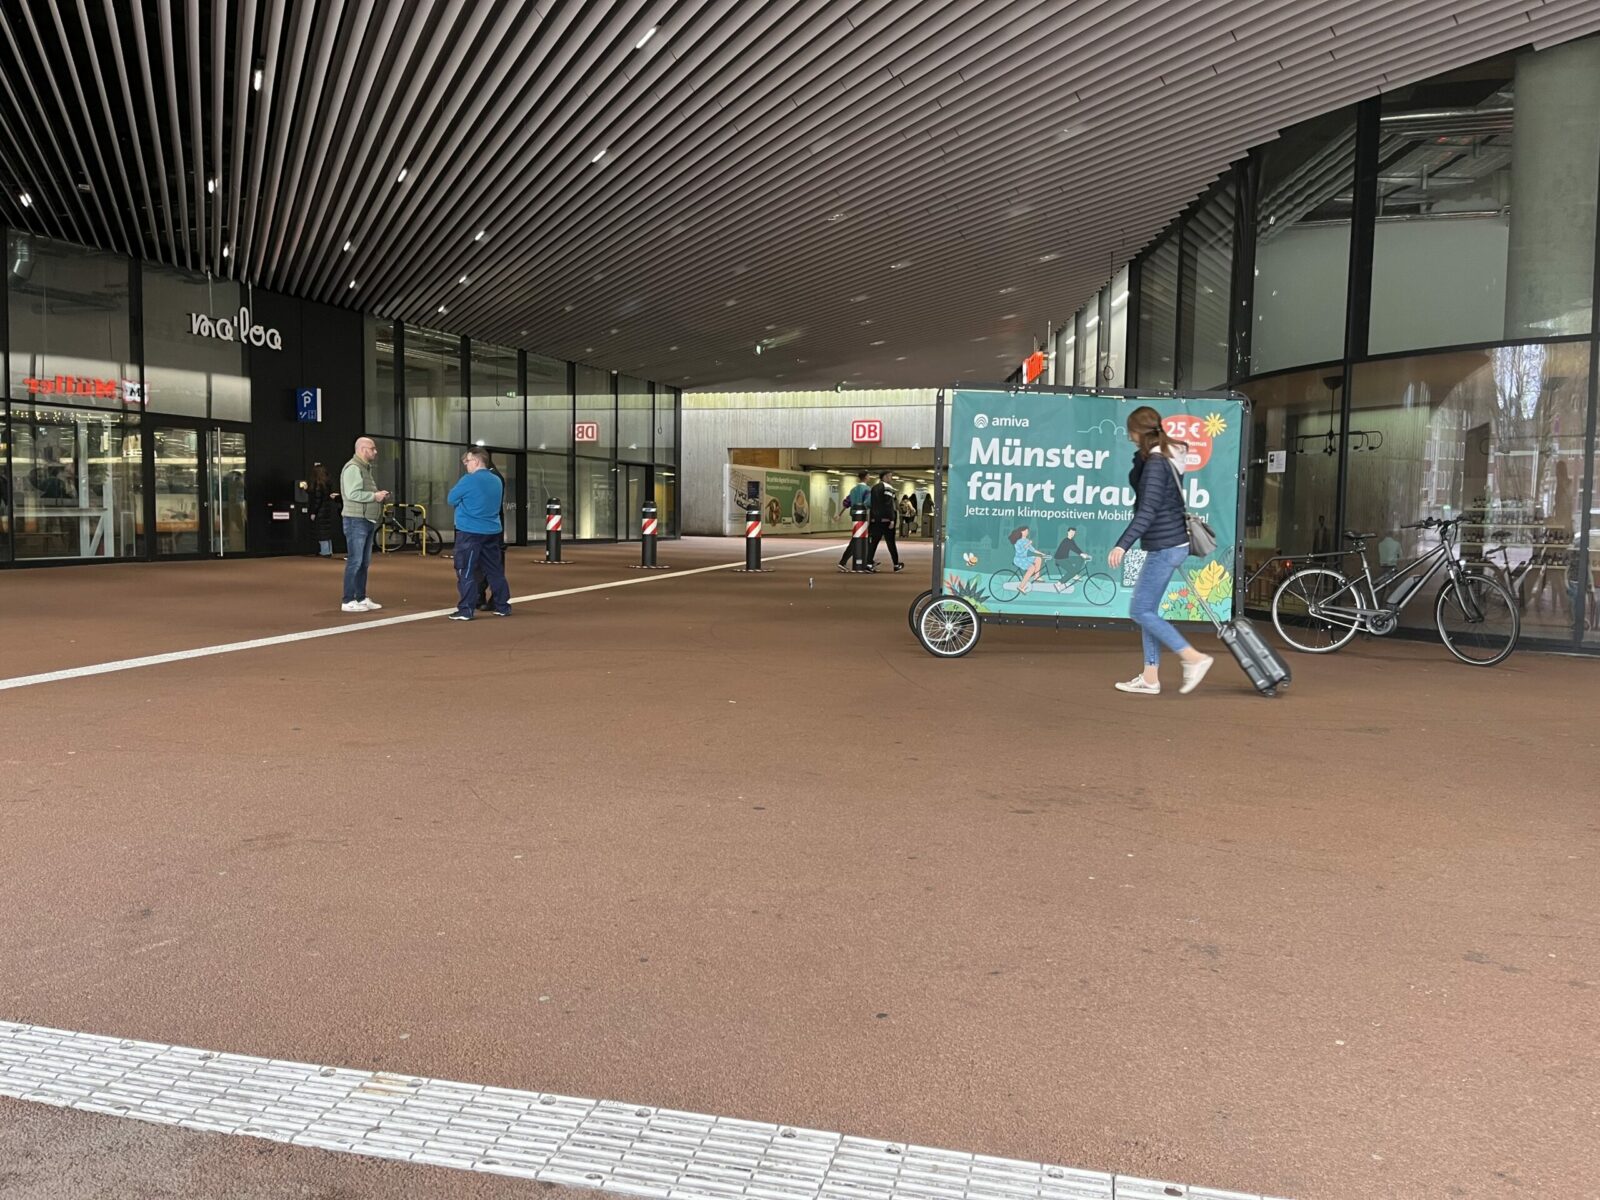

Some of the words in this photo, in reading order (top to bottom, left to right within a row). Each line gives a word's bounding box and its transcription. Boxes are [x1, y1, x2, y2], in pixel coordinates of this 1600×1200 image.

[191, 306, 282, 350] ma'loa
[992, 415, 1030, 427] amiva
[1166, 421, 1186, 438] 25
[1189, 422, 1201, 438] €
[856, 424, 878, 439] DB
[969, 437, 1110, 470] Münster
[967, 471, 1055, 503] fährt
[1062, 475, 1137, 506] drau
[964, 505, 989, 518] Jetzt
[992, 507, 1015, 517] zum
[1017, 506, 1095, 520] klimapositiven
